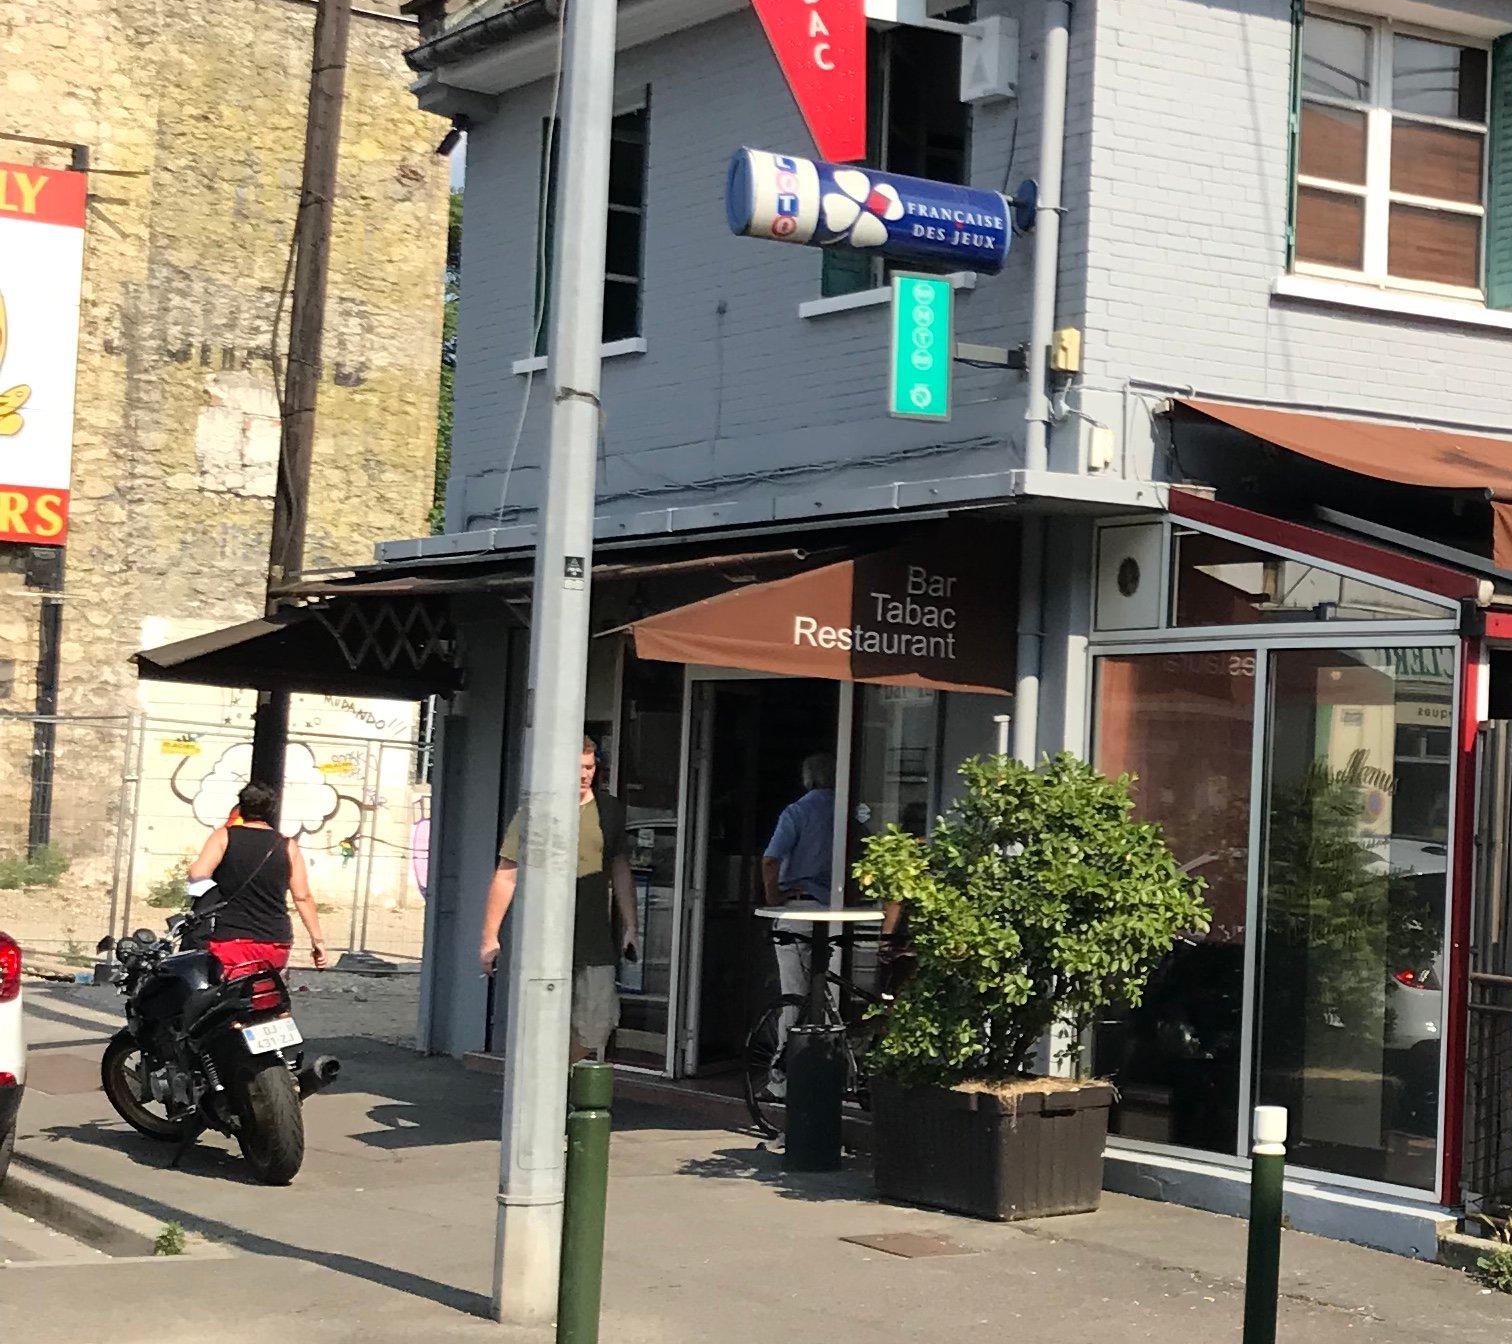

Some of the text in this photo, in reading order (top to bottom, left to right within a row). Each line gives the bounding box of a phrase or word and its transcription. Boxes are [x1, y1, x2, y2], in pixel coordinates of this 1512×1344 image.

[906, 202, 1004, 230] FRANÇAISE
[911, 223, 996, 250] DES JEUX
[907, 565, 957, 597] Bar
[870, 592, 957, 630] Tabac
[793, 615, 957, 660] Restaurant
